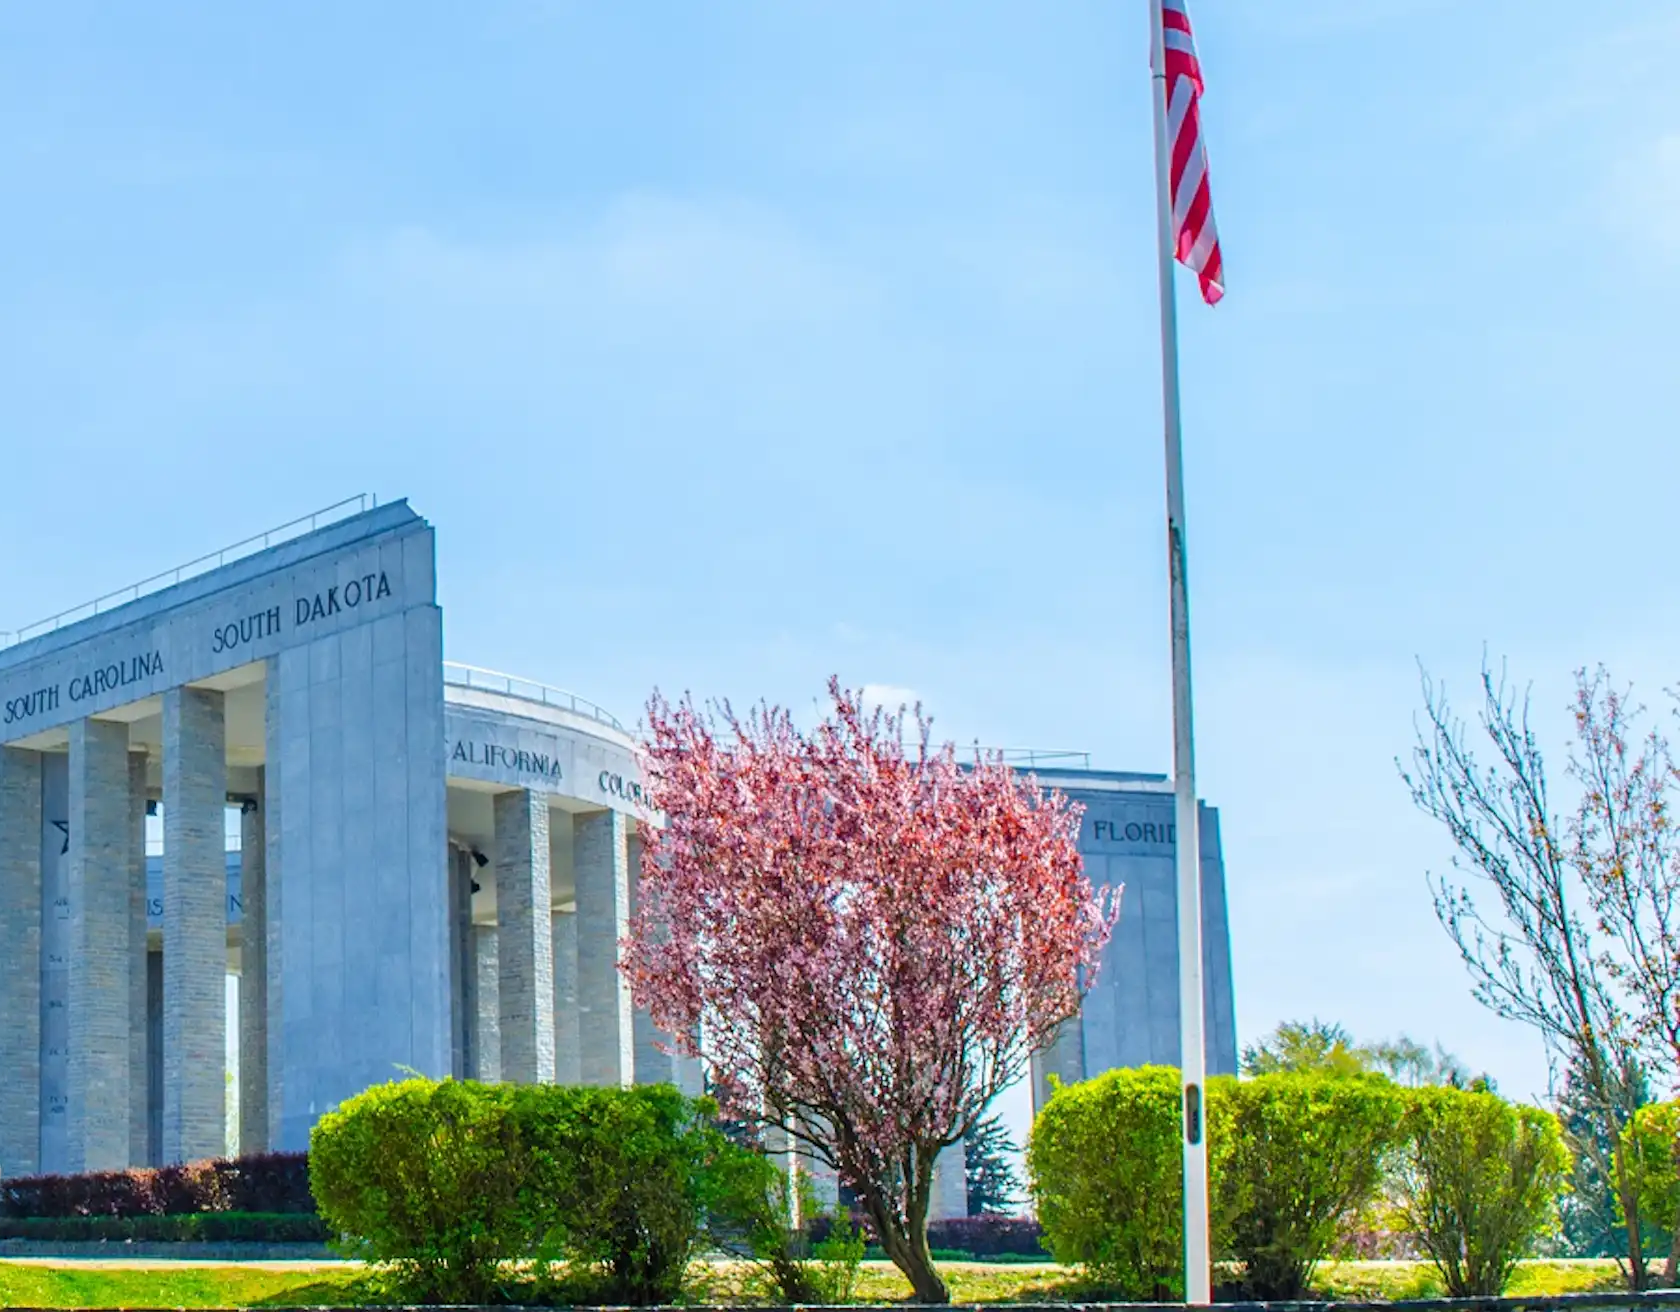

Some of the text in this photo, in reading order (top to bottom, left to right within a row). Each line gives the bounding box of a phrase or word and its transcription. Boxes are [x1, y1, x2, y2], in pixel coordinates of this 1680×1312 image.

[3, 571, 392, 724] SOUTH CAROLINA SOUTH DAKOTA
[446, 740, 563, 779] ALIFORNIA
[1093, 821, 1176, 844] FLORID
